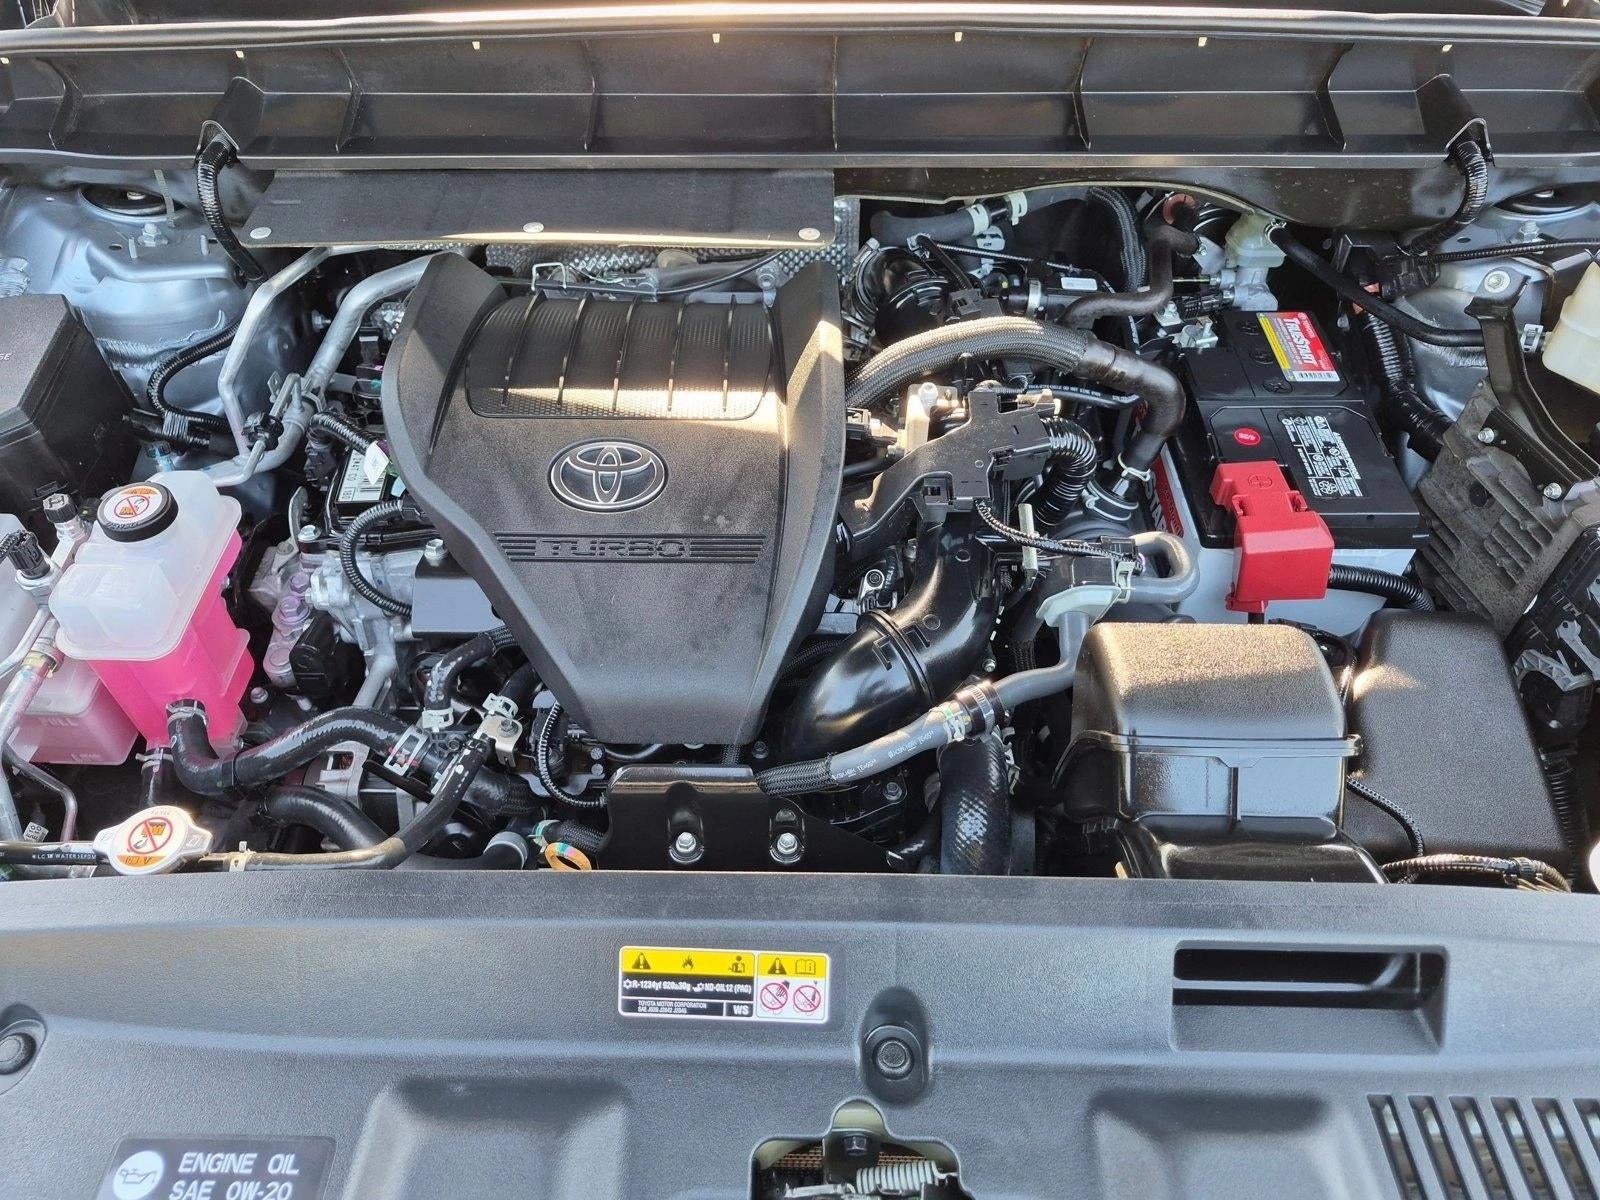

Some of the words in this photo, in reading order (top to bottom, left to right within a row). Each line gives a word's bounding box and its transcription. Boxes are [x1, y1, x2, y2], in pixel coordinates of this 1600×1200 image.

[541, 539, 684, 557] TURBO
[733, 1004, 749, 1015] WS
[178, 1151, 258, 1174] ENGINE
[267, 1153, 299, 1175] OIL
[168, 1180, 216, 1200] SAE
[225, 1180, 293, 1200] 0W-20
